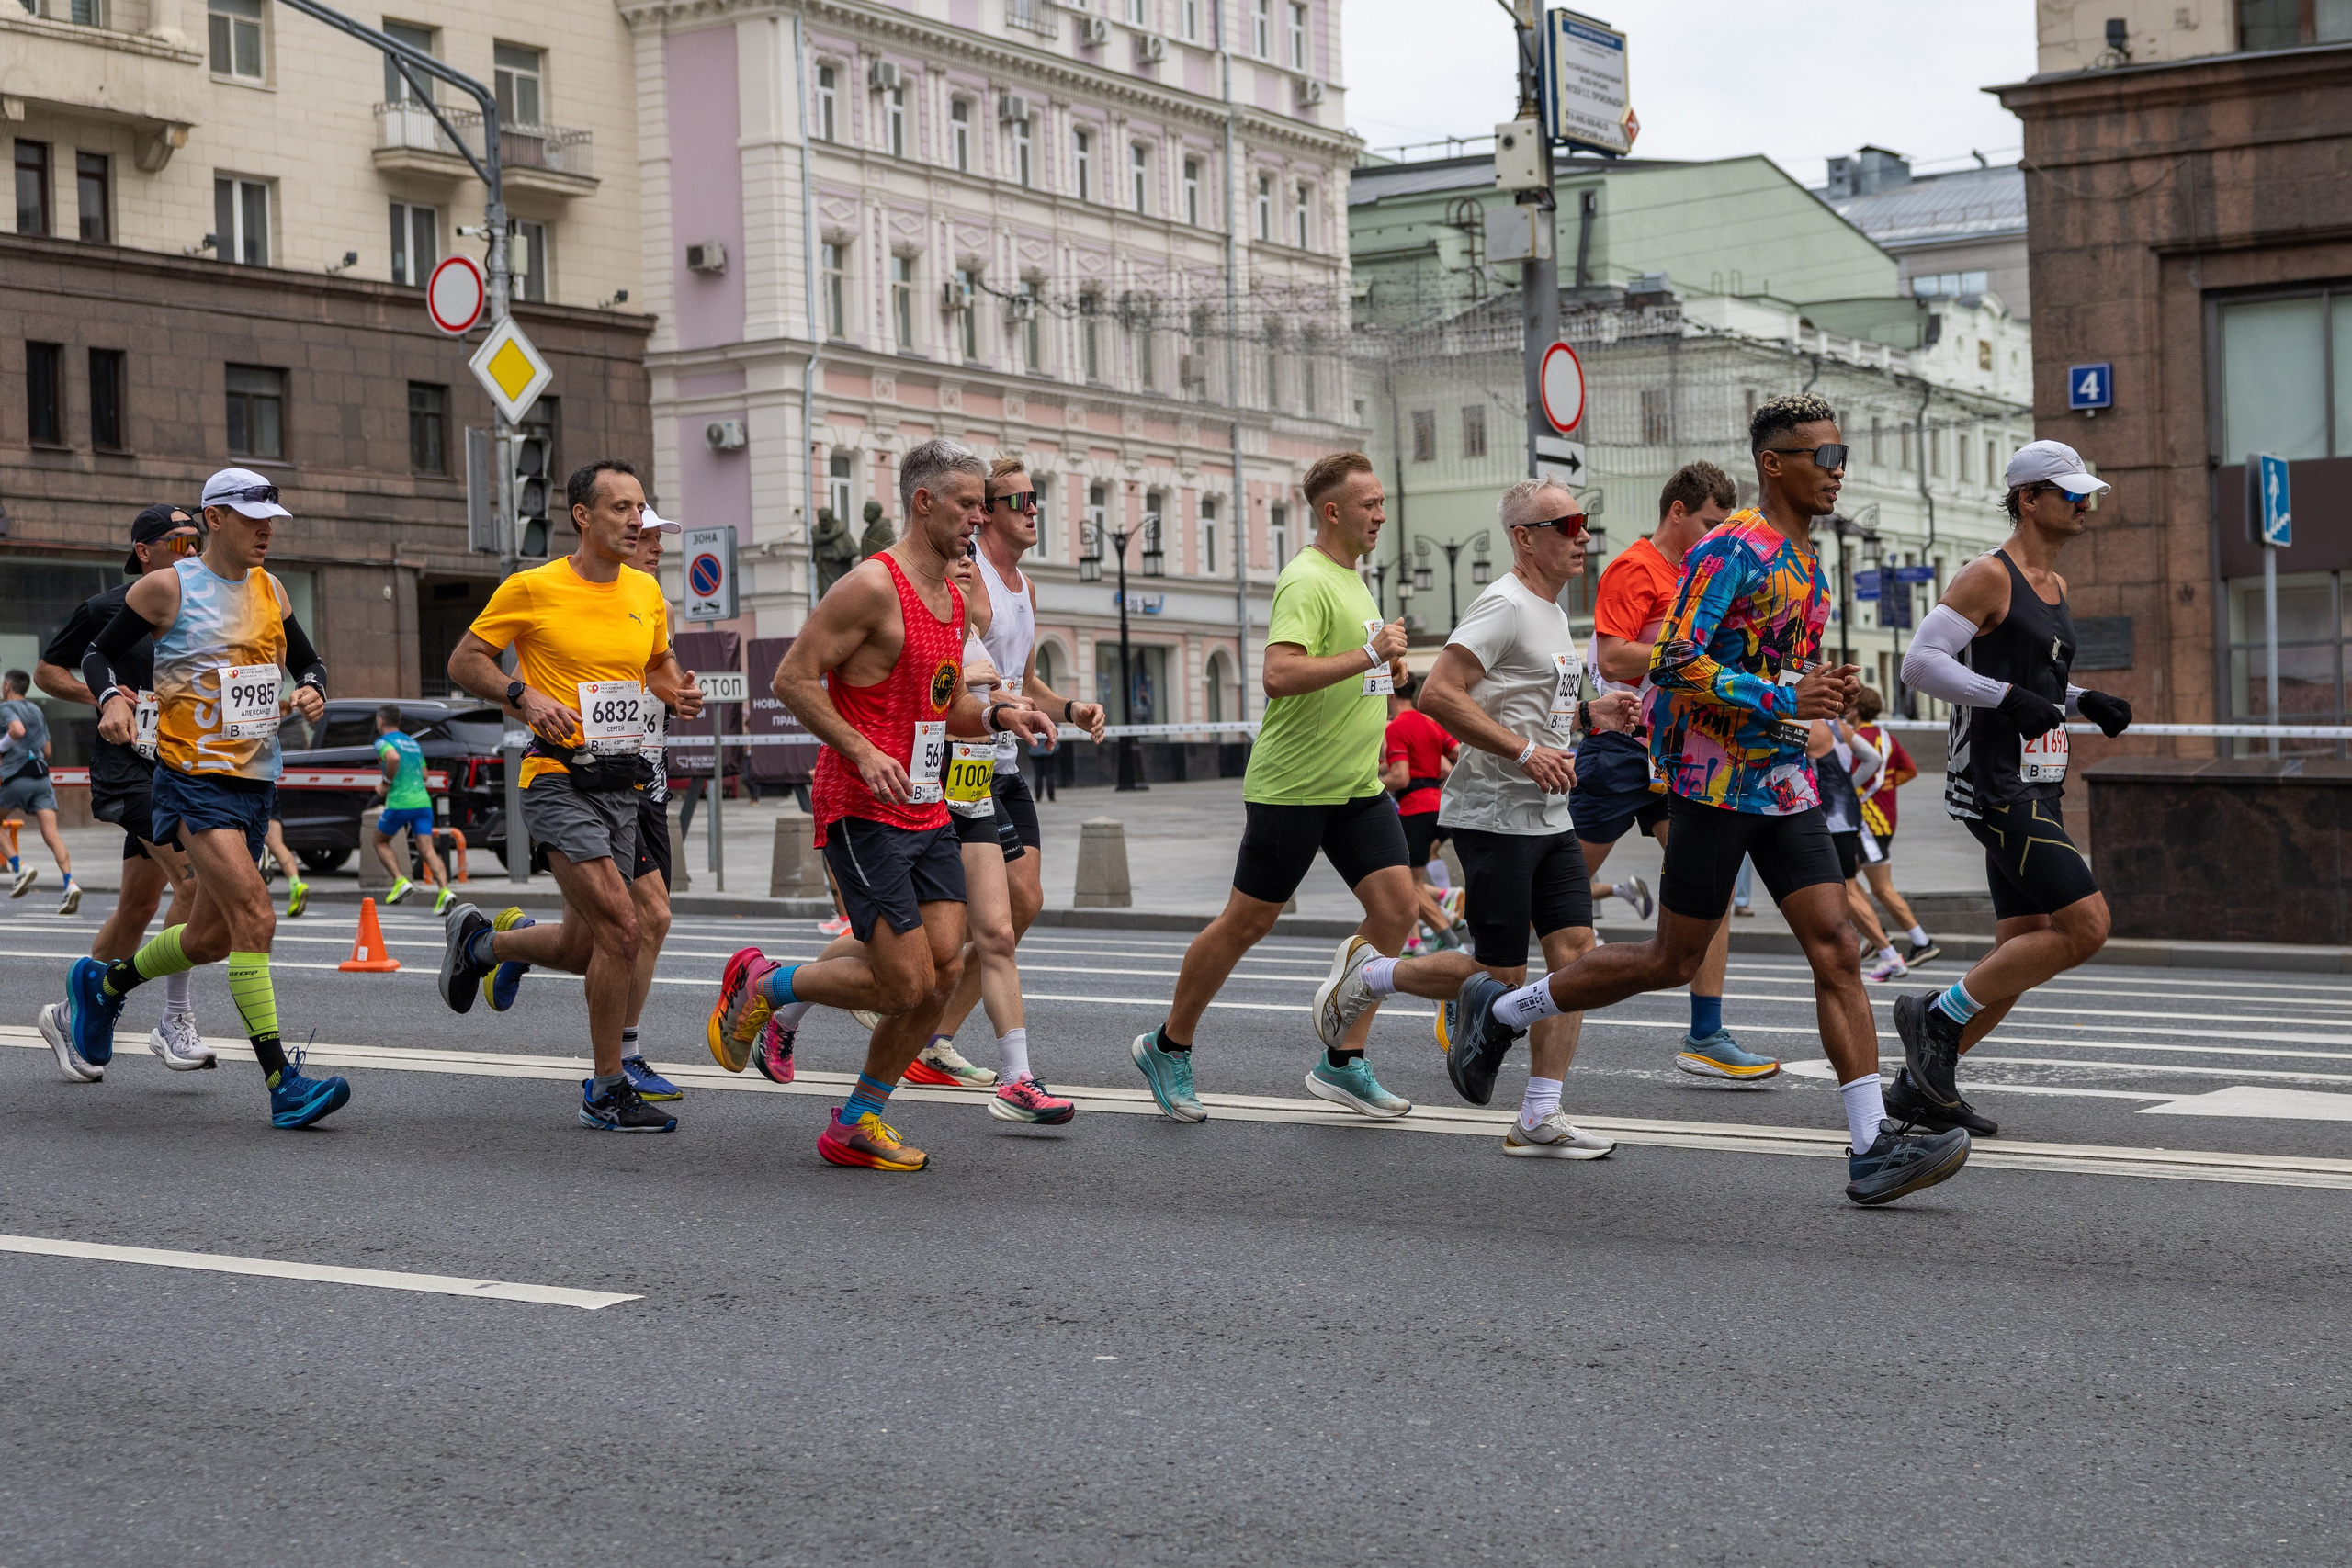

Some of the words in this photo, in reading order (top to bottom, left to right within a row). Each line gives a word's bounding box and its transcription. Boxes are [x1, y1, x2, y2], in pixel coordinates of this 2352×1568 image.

[2077, 370, 2101, 400] 4
[693, 531, 718, 545] ЗОНА
[702, 679, 741, 697] СТОП
[1370, 680, 1376, 692] B
[1559, 673, 1580, 697] 5283
[231, 682, 275, 708] 9985
[752, 698, 786, 710] НОВА
[241, 708, 271, 716] АЛЕКСАНДР
[592, 699, 639, 723] 6832
[230, 725, 240, 737] B
[606, 724, 625, 732] СЕРГЕЙ
[1001, 733, 1007, 744] B
[2024, 729, 2068, 753] 21692
[138, 743, 147, 755] B
[590, 740, 598, 752] B
[2030, 765, 2039, 777] B
[913, 785, 922, 800] B
